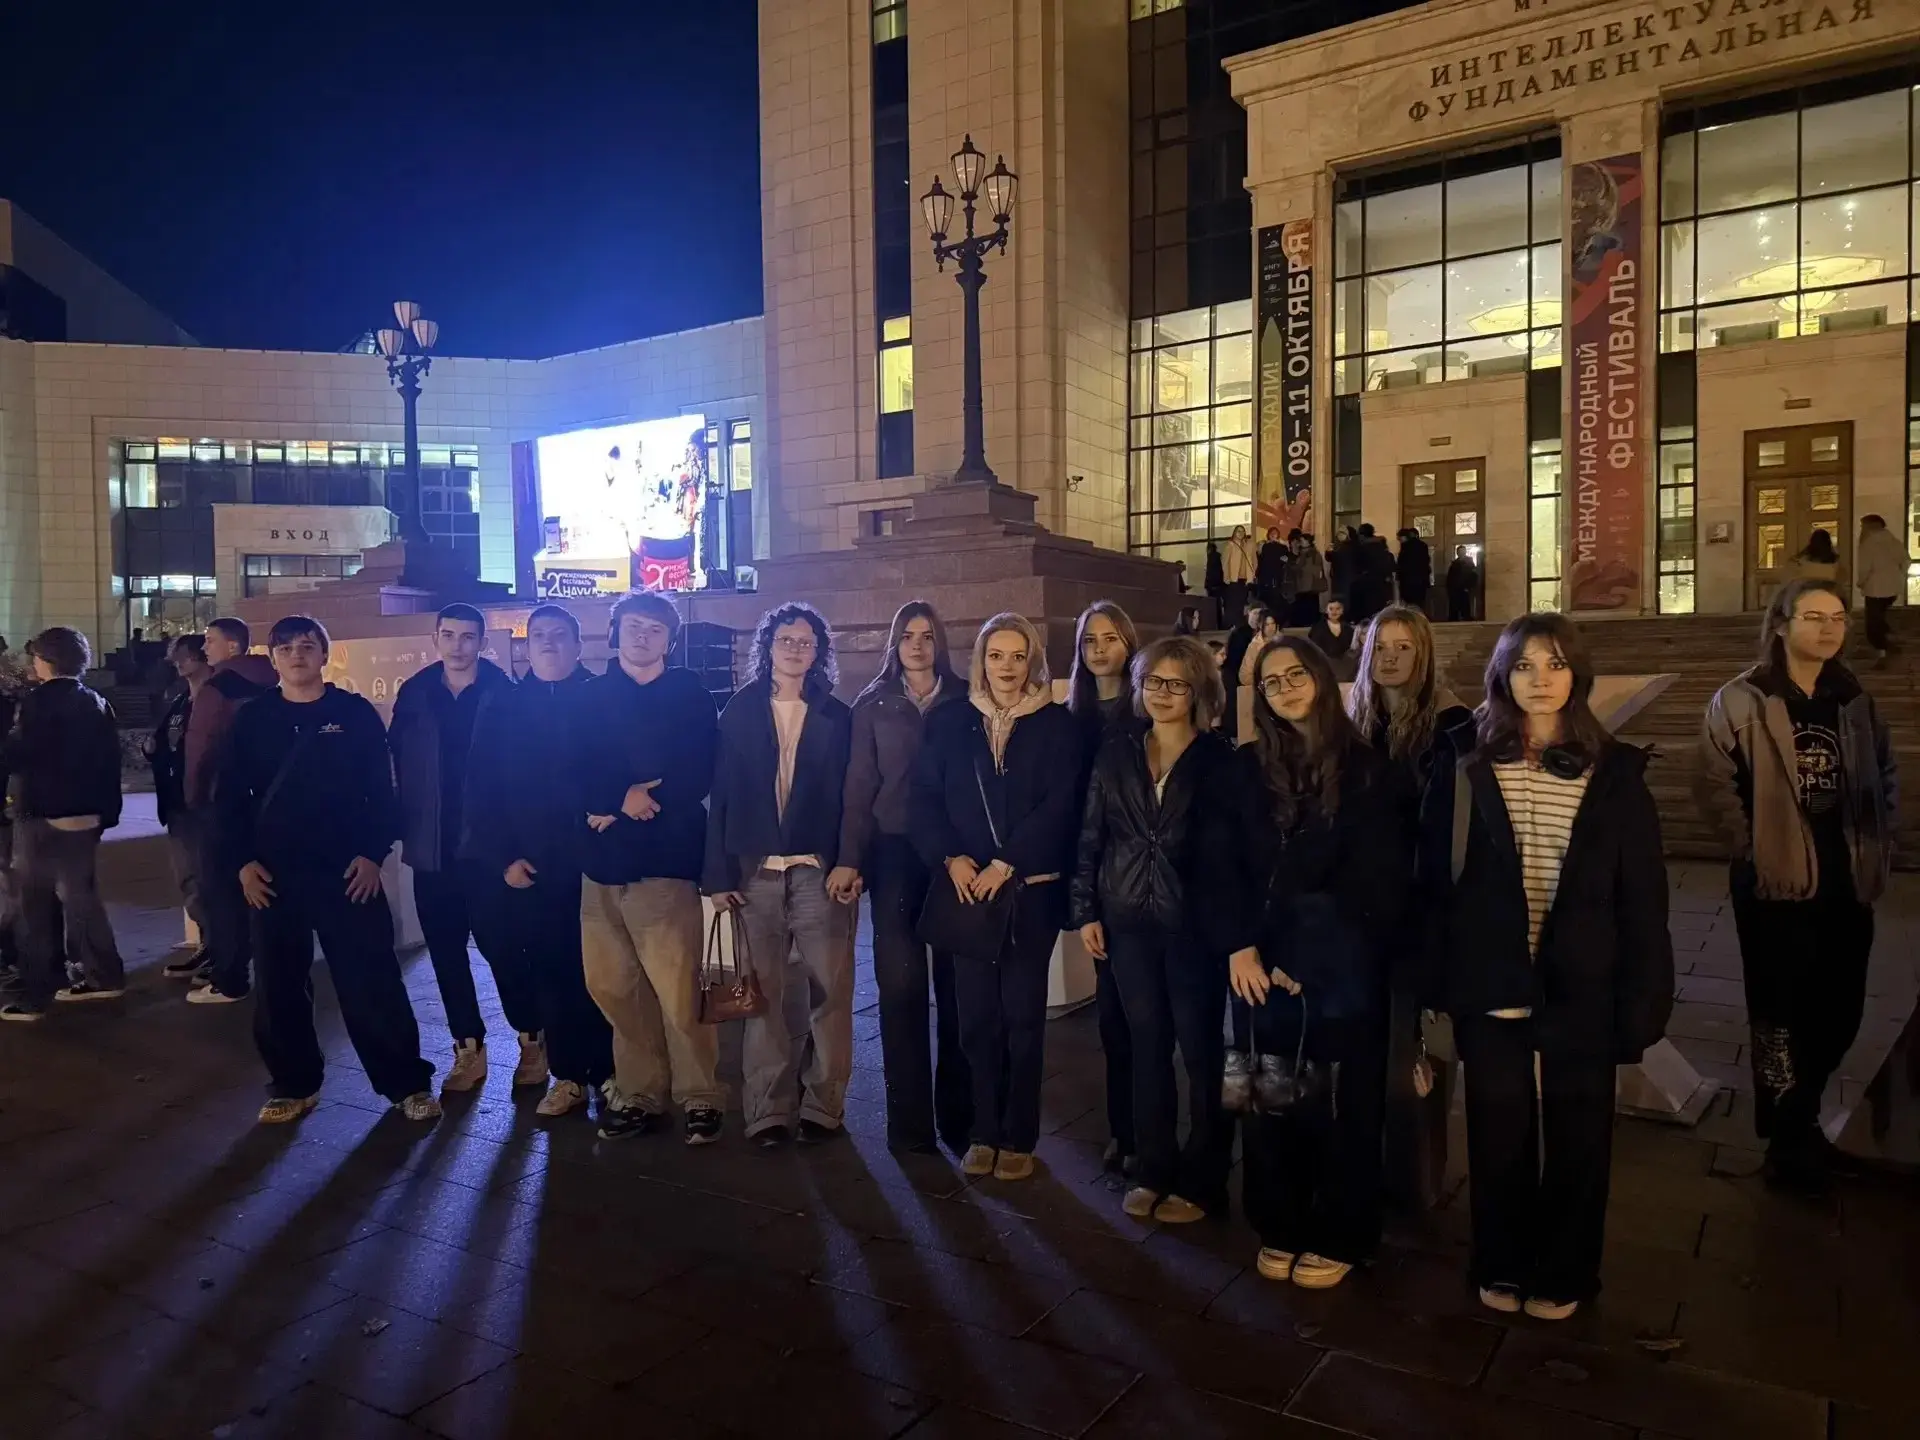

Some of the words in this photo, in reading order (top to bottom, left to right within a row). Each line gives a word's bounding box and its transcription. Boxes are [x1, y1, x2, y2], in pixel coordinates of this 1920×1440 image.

[1408, 0, 1874, 122] ФУНДАМЕНТАЛЬНАЯ
[1287, 231, 1311, 378] ОКТЯБРЯ
[1607, 259, 1635, 469] ФЕСТИВАЛЬ
[1262, 361, 1279, 476] ЕХАЛИ!
[1576, 342, 1602, 562] МЕЖДУНАРОДНЫЙ
[270, 529, 329, 541] ВХОД
